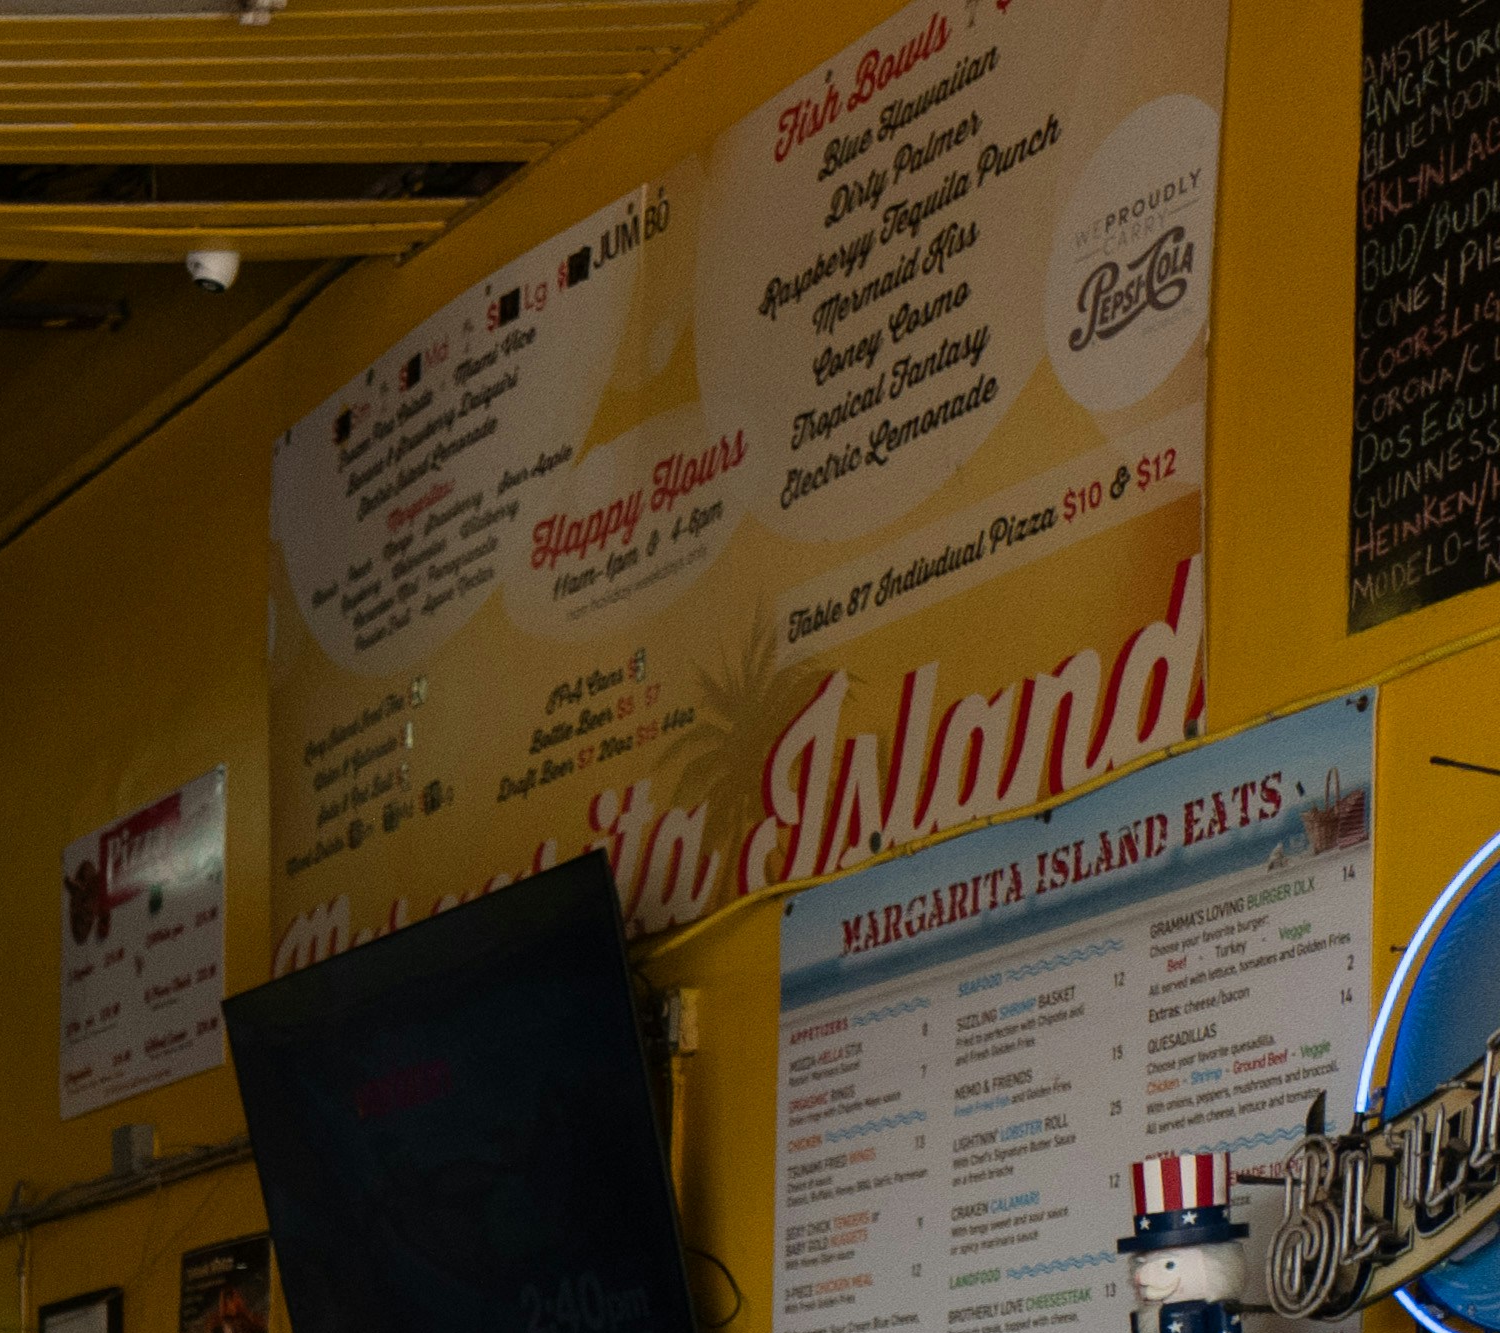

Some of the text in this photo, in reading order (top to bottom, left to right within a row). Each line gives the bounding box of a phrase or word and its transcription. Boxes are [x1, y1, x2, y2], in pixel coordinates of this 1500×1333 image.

[775, 11, 952, 162] Fish Bowls
[1363, 20, 1458, 84] AMSTEL
[1364, 46, 1451, 131] ANGRY
[817, 45, 998, 181] Blue Hawaiian
[1363, 116, 1427, 181] BLUE
[824, 110, 983, 229] Dirty Palmer
[880, 112, 1062, 247] Tequila Punch
[1103, 169, 1202, 237] PROUDLY
[812, 220, 980, 336] Mermaid Kiss
[1360, 257, 1452, 340] CONEY
[812, 280, 971, 387] Coney Cosmo
[792, 324, 991, 451] Tropical Fantasy
[781, 373, 998, 511] Electric Lemonade
[530, 428, 749, 571] Happy Hours
[787, 594, 842, 644] Table
[846, 584, 872, 617] 87
[989, 503, 1059, 556] Pizza
[1062, 481, 1103, 525] $10
[1108, 464, 1131, 500] &
[1135, 446, 1178, 493] $12
[736, 553, 1206, 893] Island
[841, 771, 1284, 958] MARGARITA ISLAND EATS
[1150, 865, 1355, 939] GRAMMA'S LOVING BURGER DLX 14
[1167, 921, 1312, 972] Beef Turkey Veggie
[1202, 924, 1235, 945] favorite
[1328, 932, 1351, 949] Fries
[1038, 972, 1125, 1008] BASKET 12
[1148, 1023, 1218, 1054] QUESADILLAS
[1233, 1040, 1331, 1074] Ground Beef Veggie
[1044, 1113, 1068, 1130] ROLL
